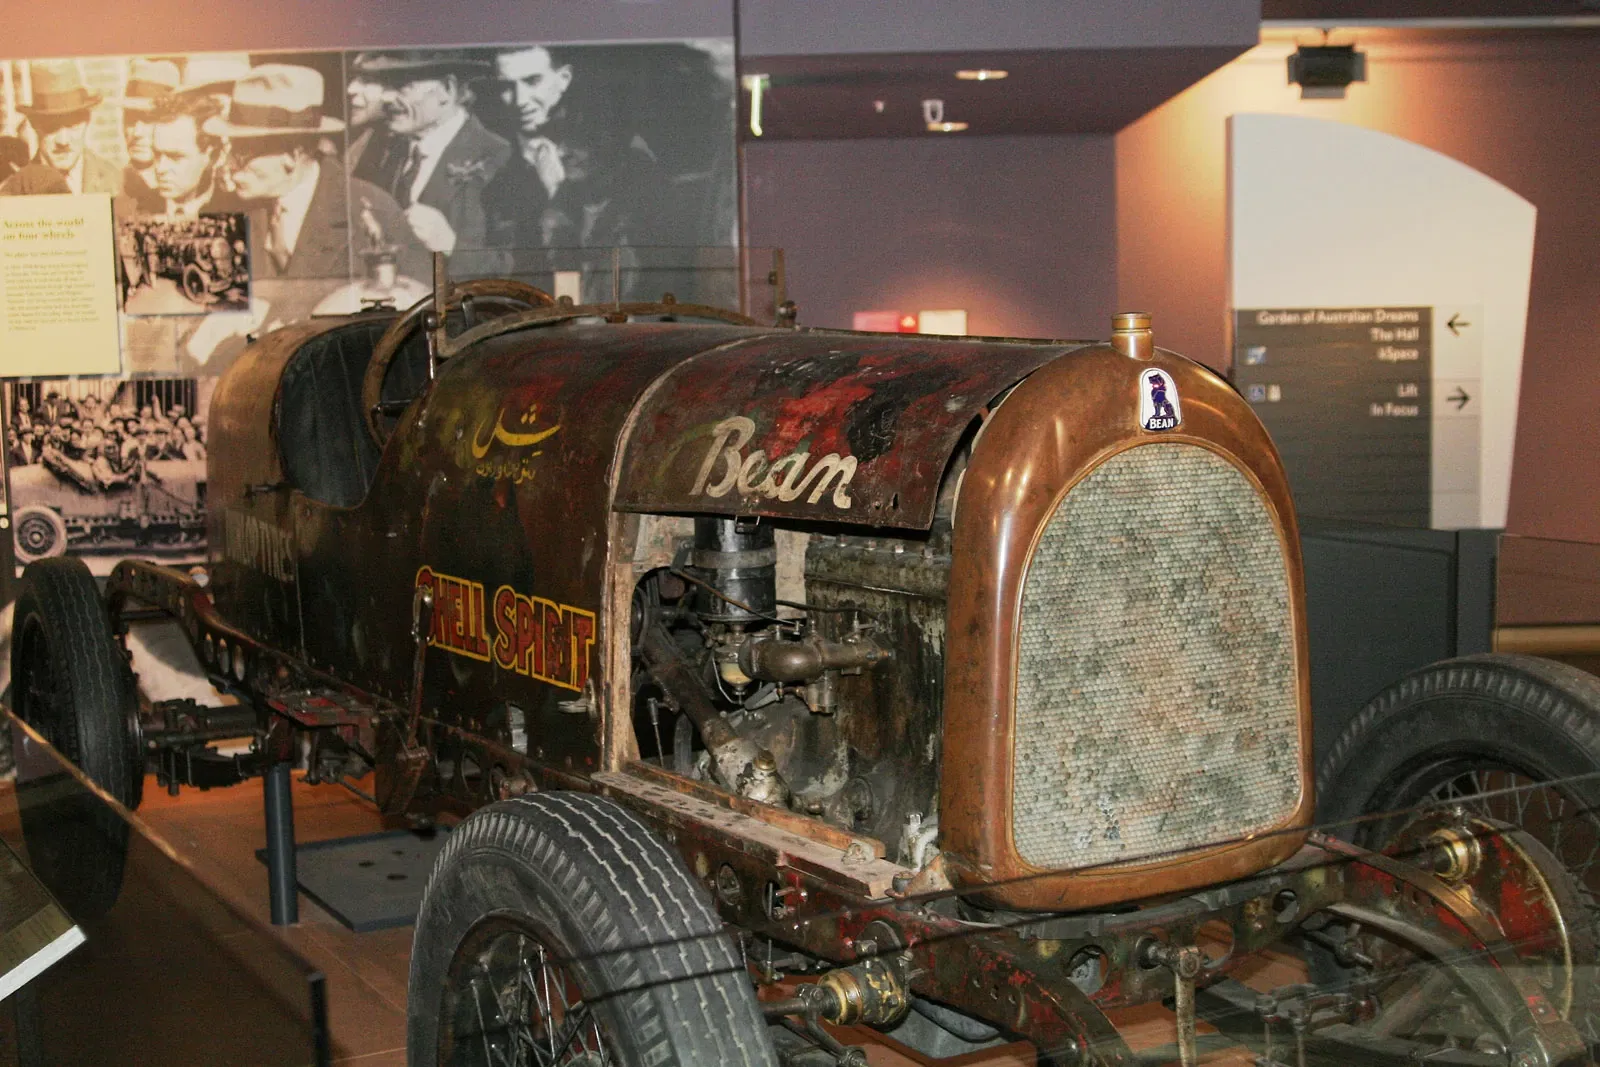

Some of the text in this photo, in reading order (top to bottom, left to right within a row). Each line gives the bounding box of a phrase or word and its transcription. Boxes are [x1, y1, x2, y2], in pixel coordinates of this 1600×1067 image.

[38, 217, 53, 227] the
[1257, 309, 1419, 325] Garden of Australian Dreams
[1371, 327, 1419, 341] The Hall
[1398, 383, 1418, 397] Lift
[1371, 403, 1418, 416] In Focus
[1149, 418, 1174, 429] BEAN
[688, 415, 858, 509] Bean
[493, 585, 596, 692] SPIRIT
